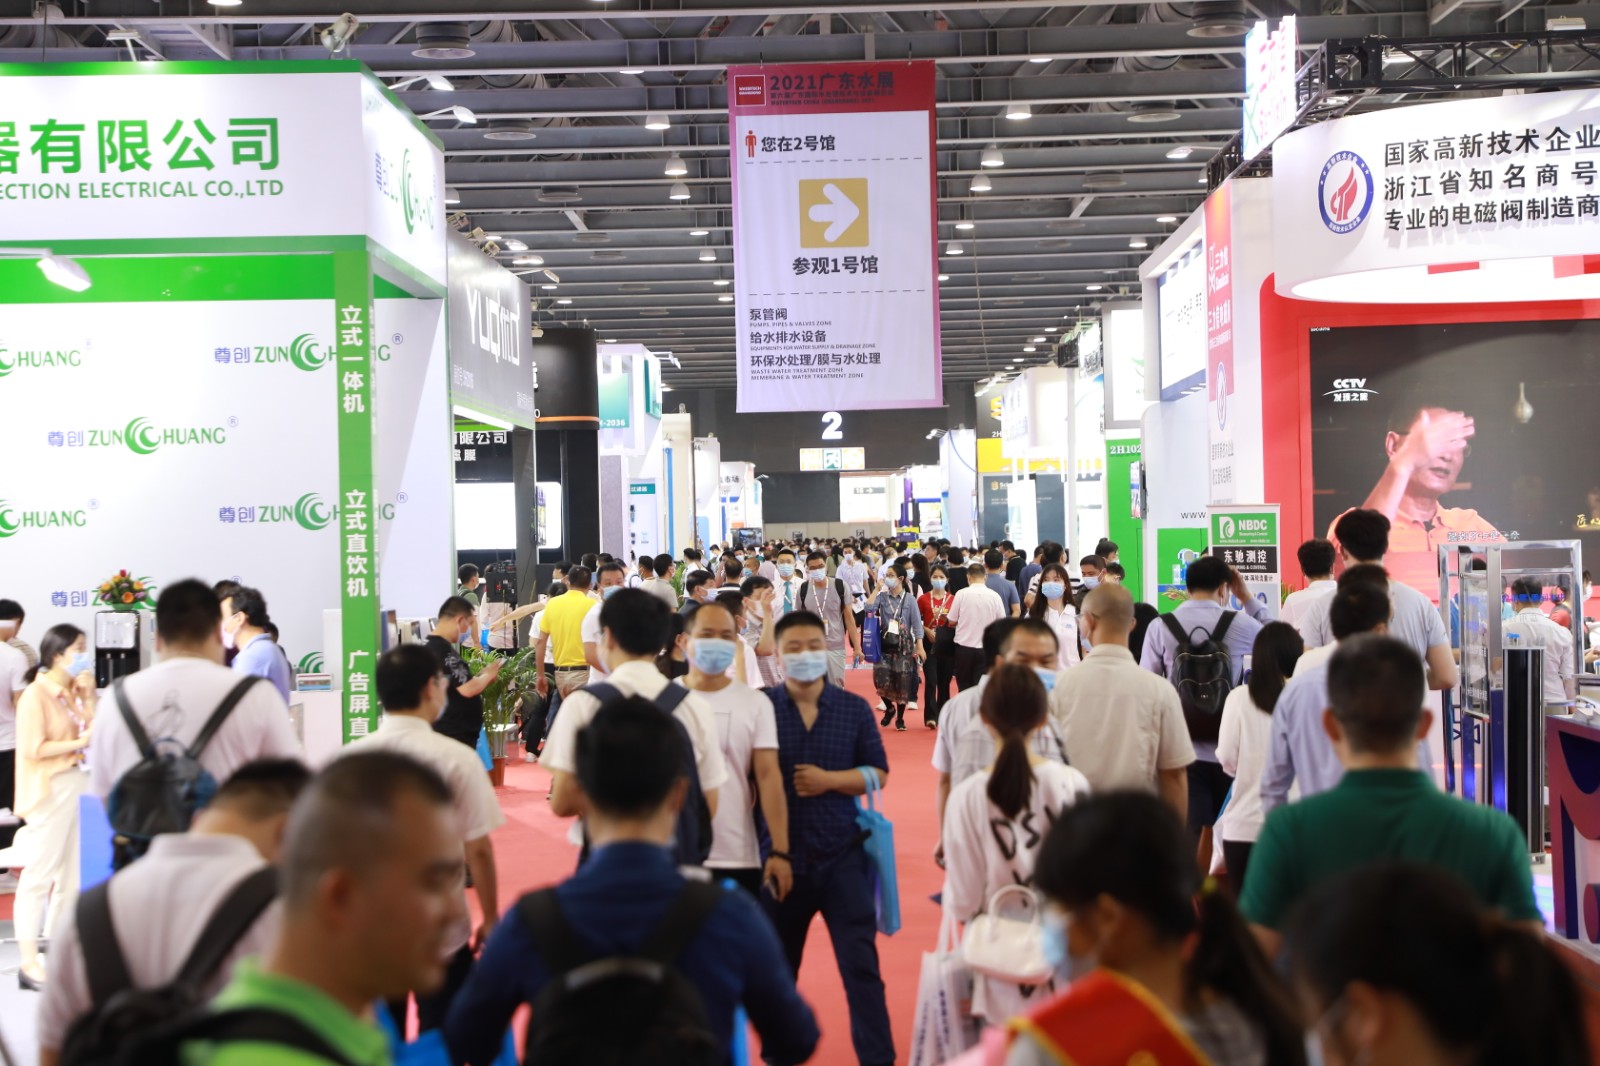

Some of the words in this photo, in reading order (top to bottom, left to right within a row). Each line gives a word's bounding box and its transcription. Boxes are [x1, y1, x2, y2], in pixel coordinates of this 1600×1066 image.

[770, 71, 894, 91] 2021广东水展
[761, 135, 835, 152] 您在2号馆
[1385, 124, 1600, 167] 国家高新技术企业
[79, 181, 198, 198] ELECTRICAL
[204, 180, 284, 199] CO.,LTD
[1384, 161, 1597, 201] 浙江省知名商号
[1384, 194, 1600, 232] 专业的电磁阀制造商
[792, 255, 878, 275] 参观1号馆
[749, 308, 787, 321] 泵管阀
[750, 330, 826, 344] 给水排水设备
[341, 305, 365, 413] 立式一体机
[750, 352, 881, 367] 环保水处理/膜与水处理
[1333, 378, 1367, 388] CCTV
[821, 411, 843, 440] 2
[1238, 519, 1267, 531] NBDC
[345, 490, 369, 597] 立式直饮机
[1223, 549, 1267, 563] 东驰测控
[348, 650, 371, 745] 广告屏直
